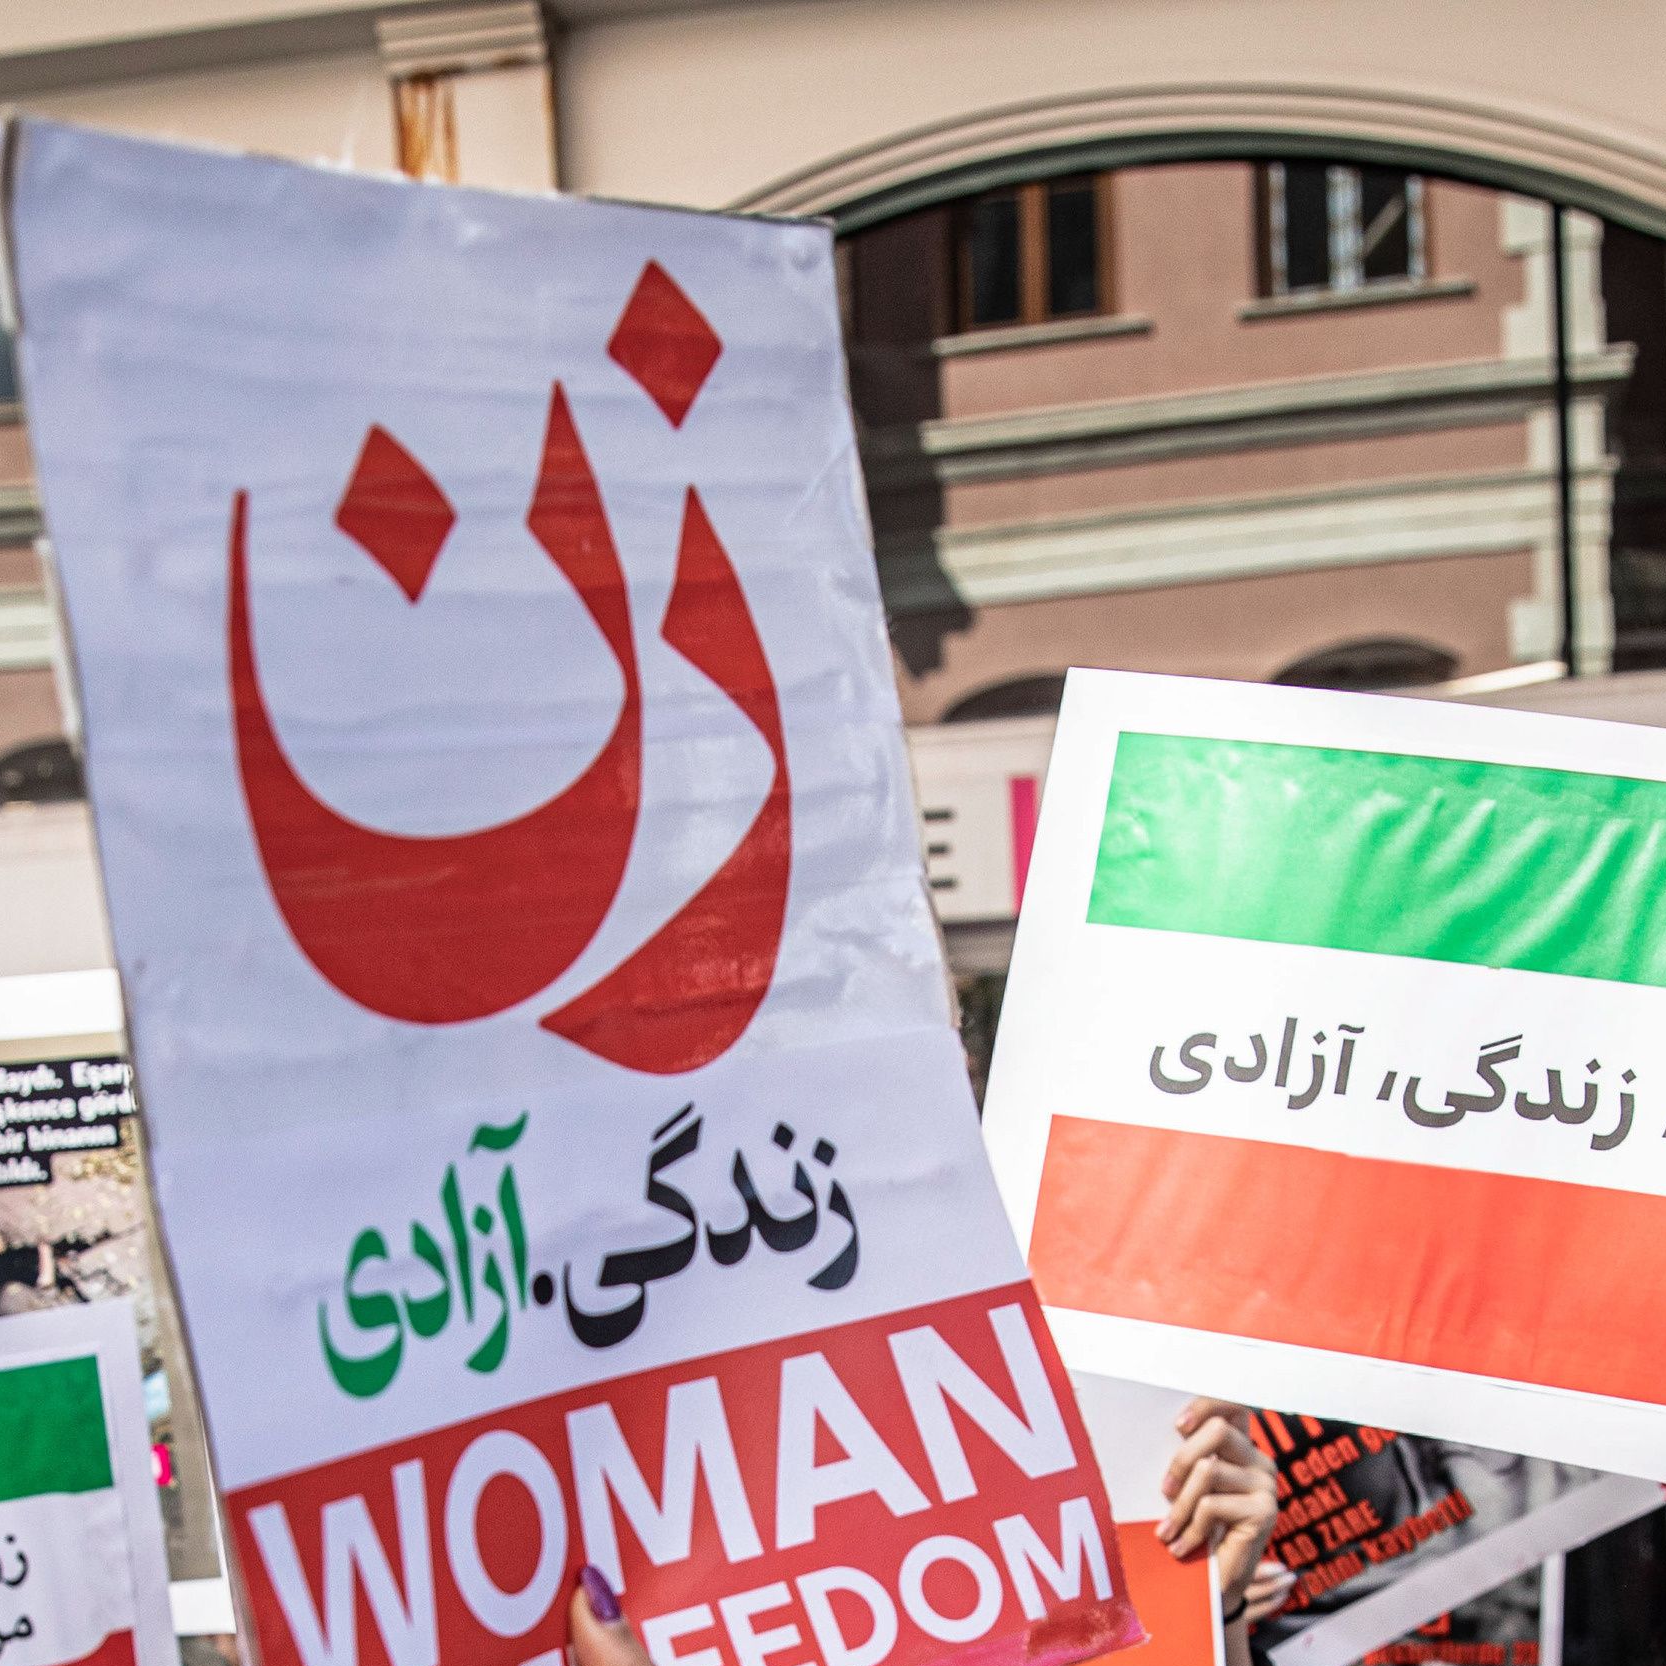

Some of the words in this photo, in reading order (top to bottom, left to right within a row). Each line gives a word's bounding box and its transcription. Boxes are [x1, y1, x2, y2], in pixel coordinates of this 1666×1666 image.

[226, 258, 793, 1076] زن
[78, 1088, 137, 1123] görd
[1148, 1014, 1367, 1111] آزادی
